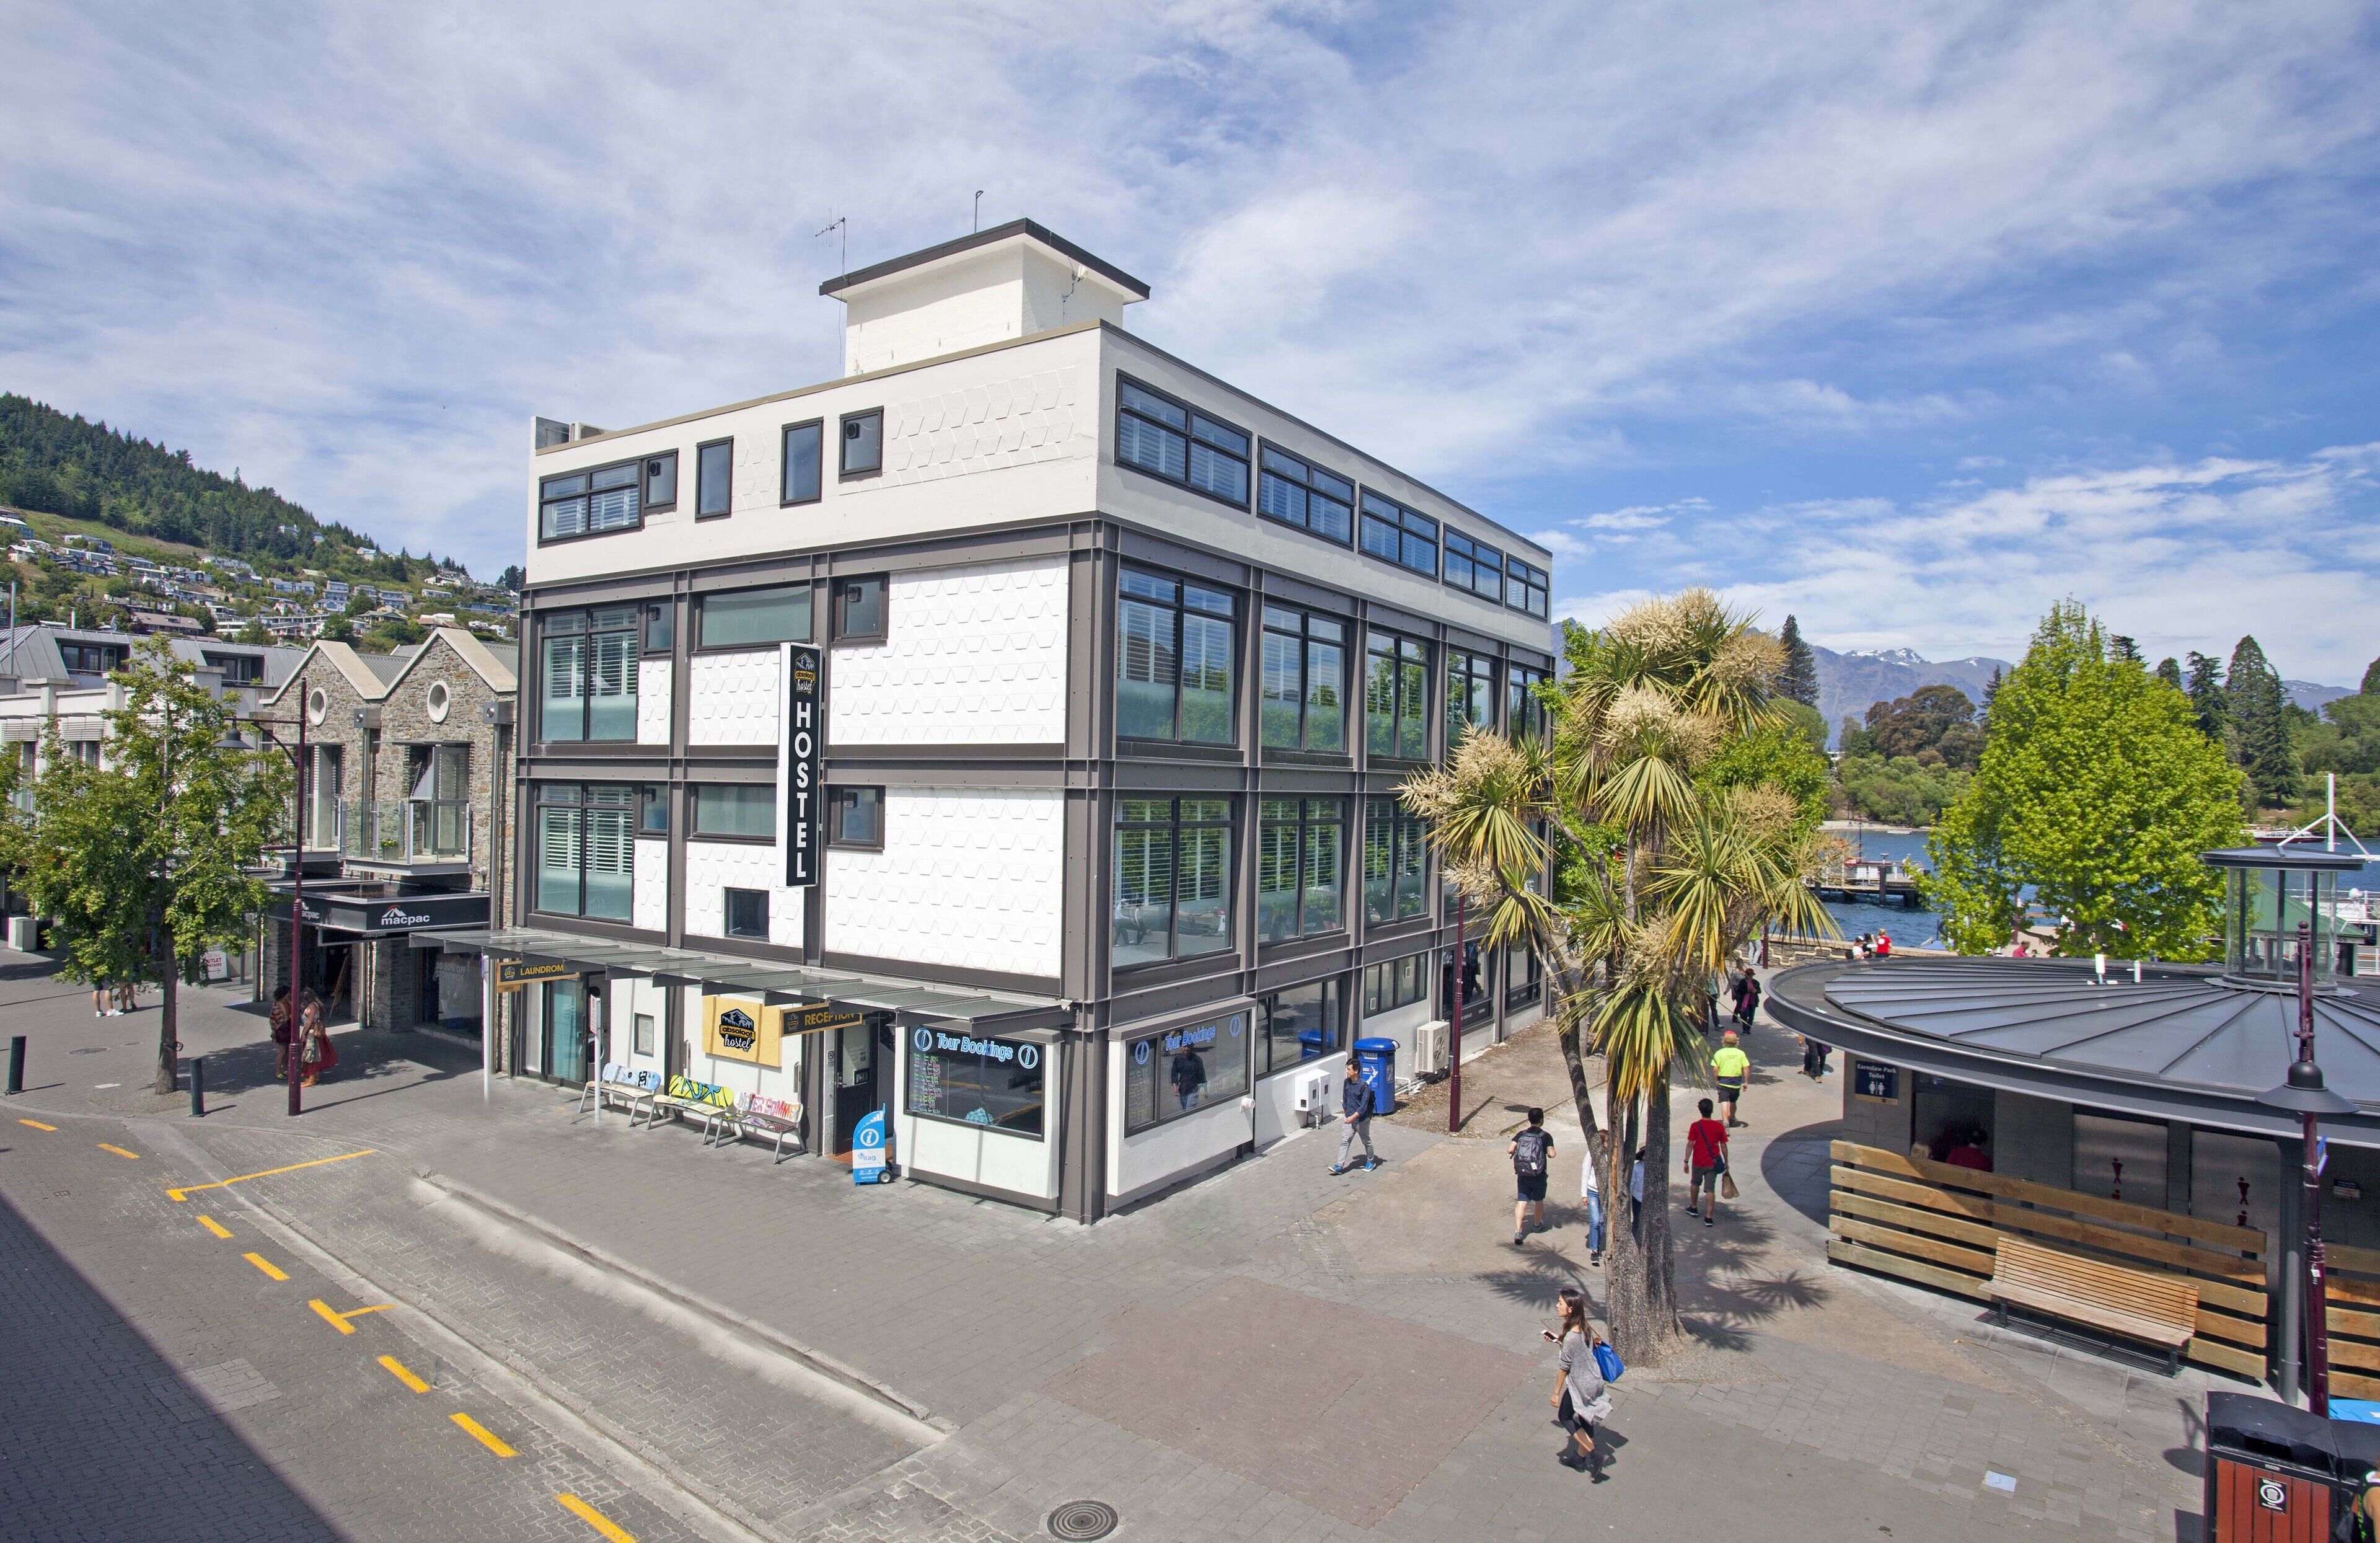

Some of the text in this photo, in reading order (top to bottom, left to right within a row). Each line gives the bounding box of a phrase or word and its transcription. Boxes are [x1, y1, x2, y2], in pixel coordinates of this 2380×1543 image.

[797, 678, 813, 691] hostel
[795, 701, 812, 878] HOSTEL
[381, 914, 430, 926] macpac
[723, 1027, 752, 1037] absoloot
[1165, 1026, 1216, 1051] Tour Bookings
[725, 1034, 751, 1049] hostel
[937, 1032, 1014, 1062] Tour Bookings
